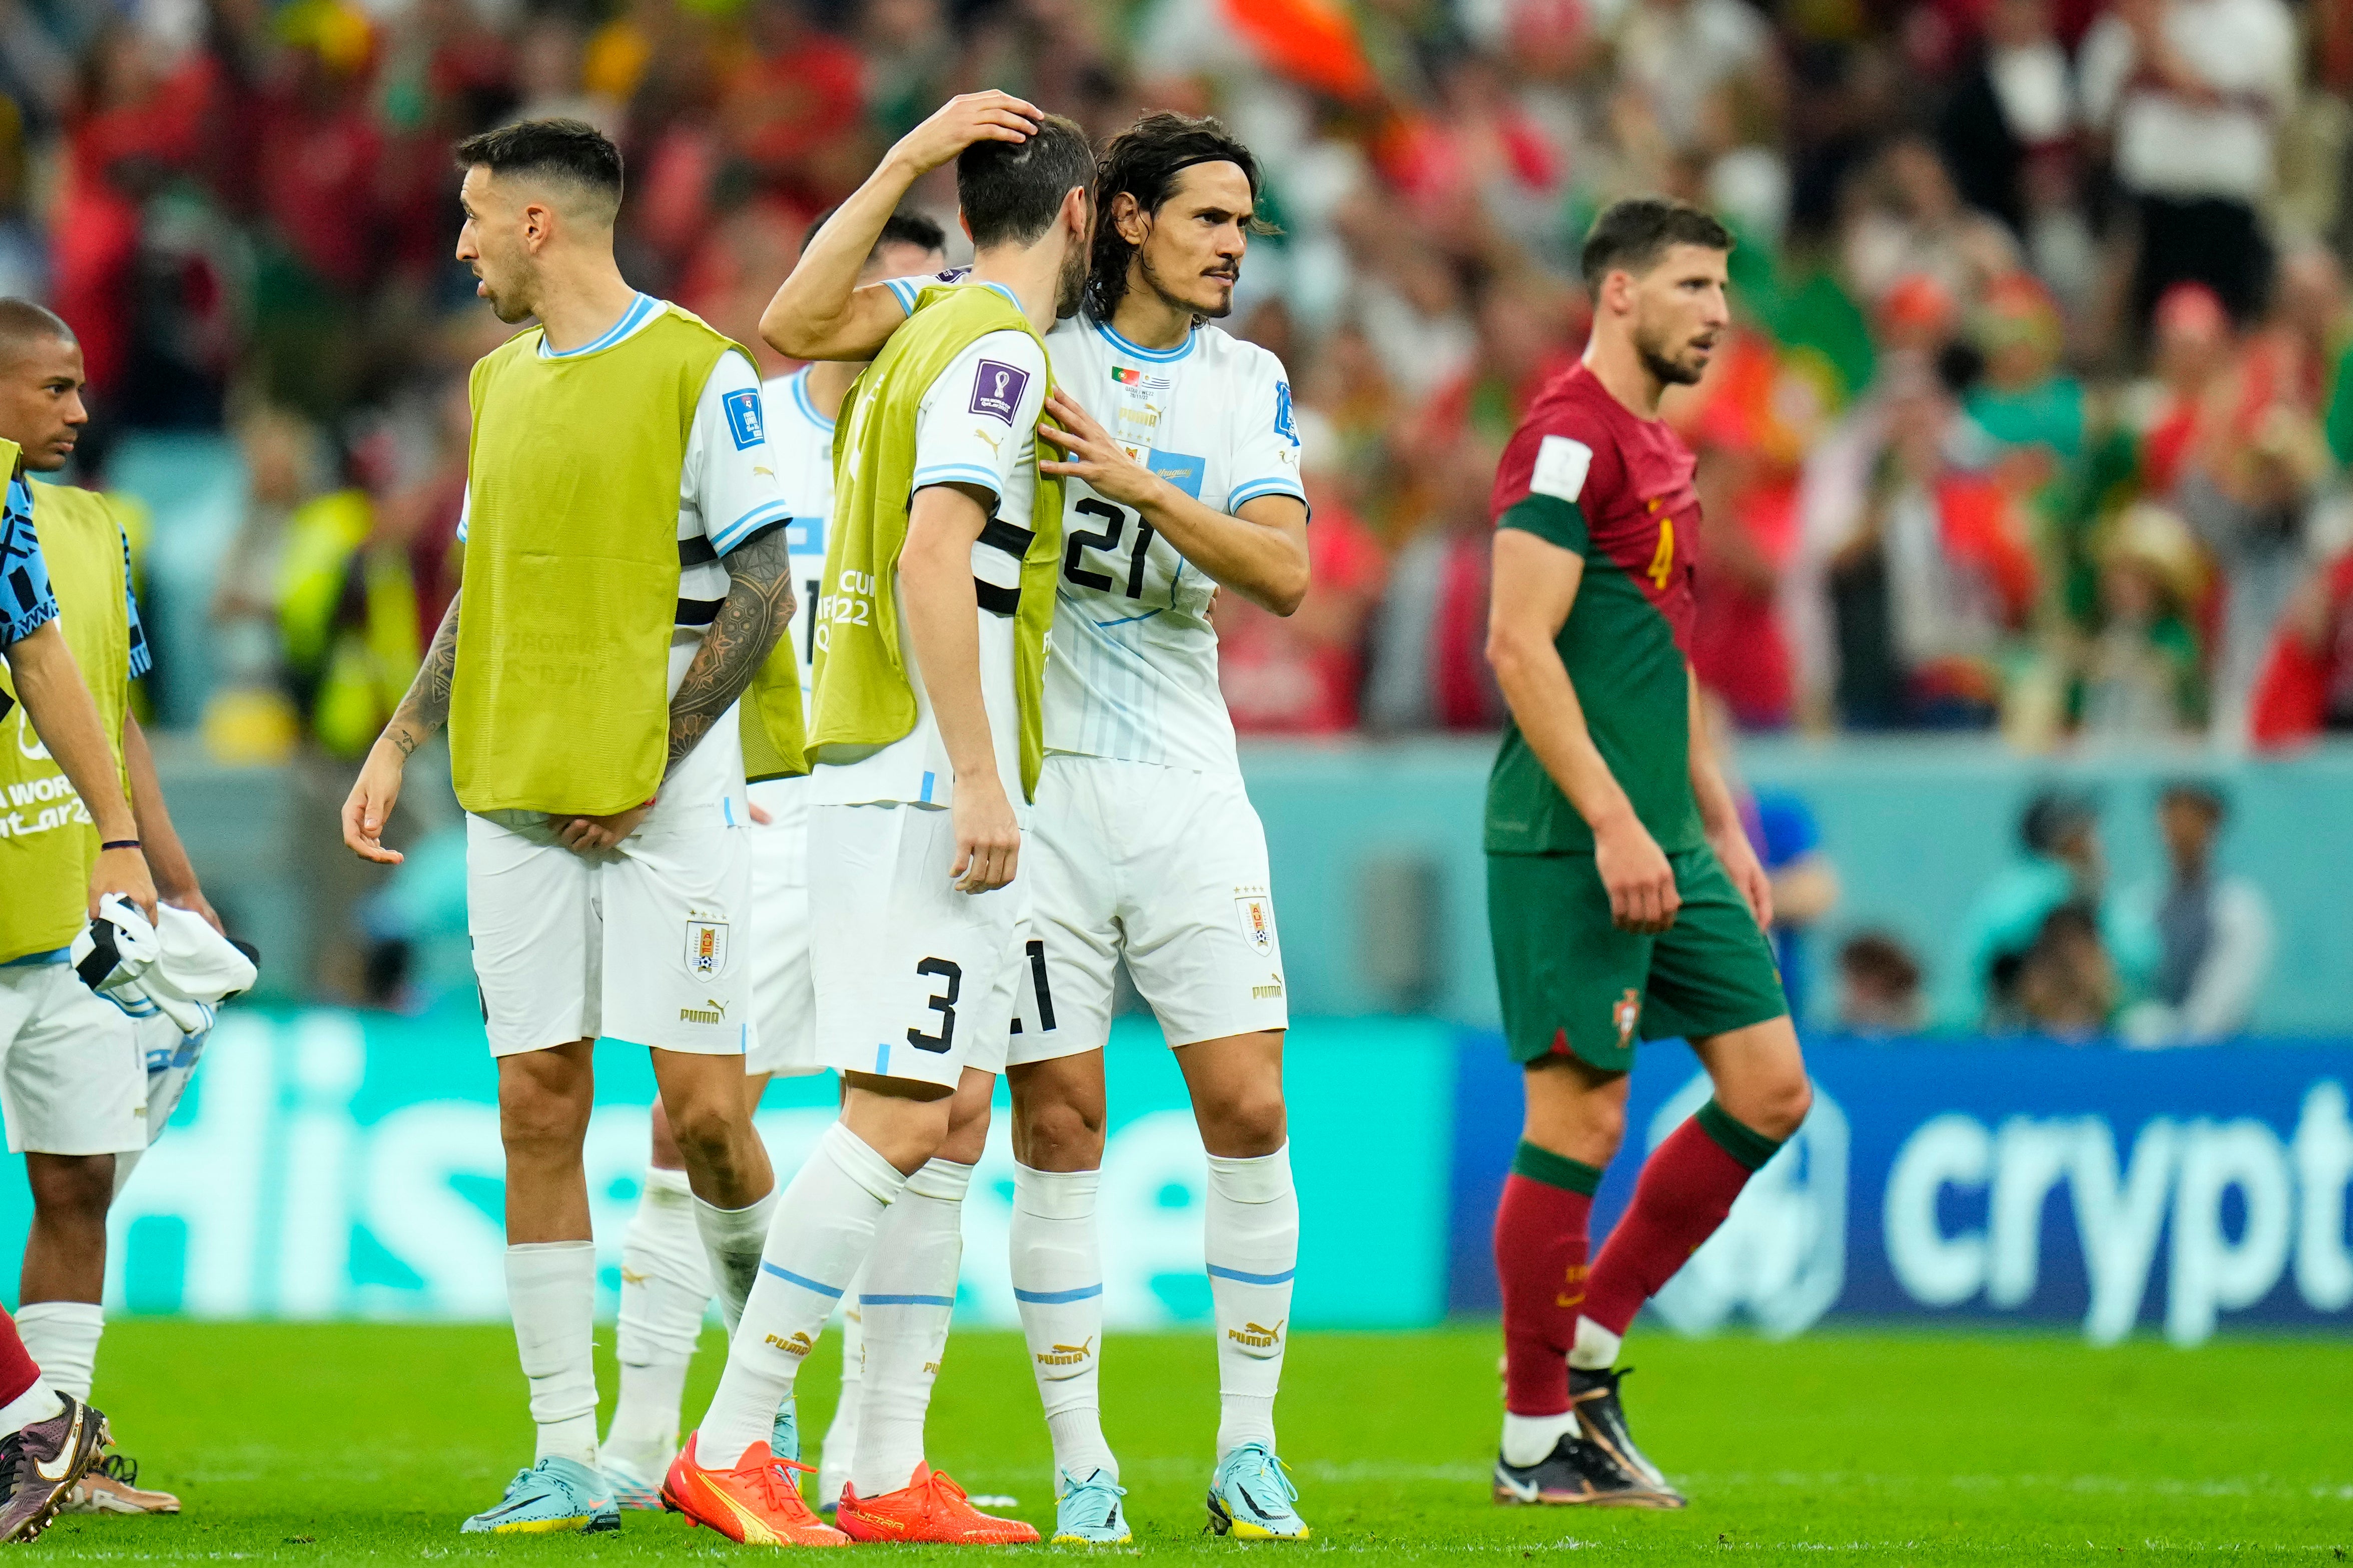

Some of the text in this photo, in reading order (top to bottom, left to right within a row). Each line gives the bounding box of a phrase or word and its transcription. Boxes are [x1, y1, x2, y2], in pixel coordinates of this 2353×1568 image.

[1119, 407, 1157, 428] PUMA
[1064, 497, 1154, 599] 21
[1647, 517, 1674, 590] 4
[8, 775, 74, 807] WOR
[1253, 907, 1263, 928] AUF
[702, 933, 712, 954] AUF
[1010, 940, 1056, 1034] 1
[1253, 986, 1282, 1000] PUMA
[907, 957, 962, 1054] 3
[680, 1009, 719, 1025] PUMA
[1883, 1076, 2353, 1347] crypt
[1229, 1329, 1272, 1347] PUMA
[923, 1362, 940, 1375] PU
[1037, 1352, 1083, 1365] PUMA
